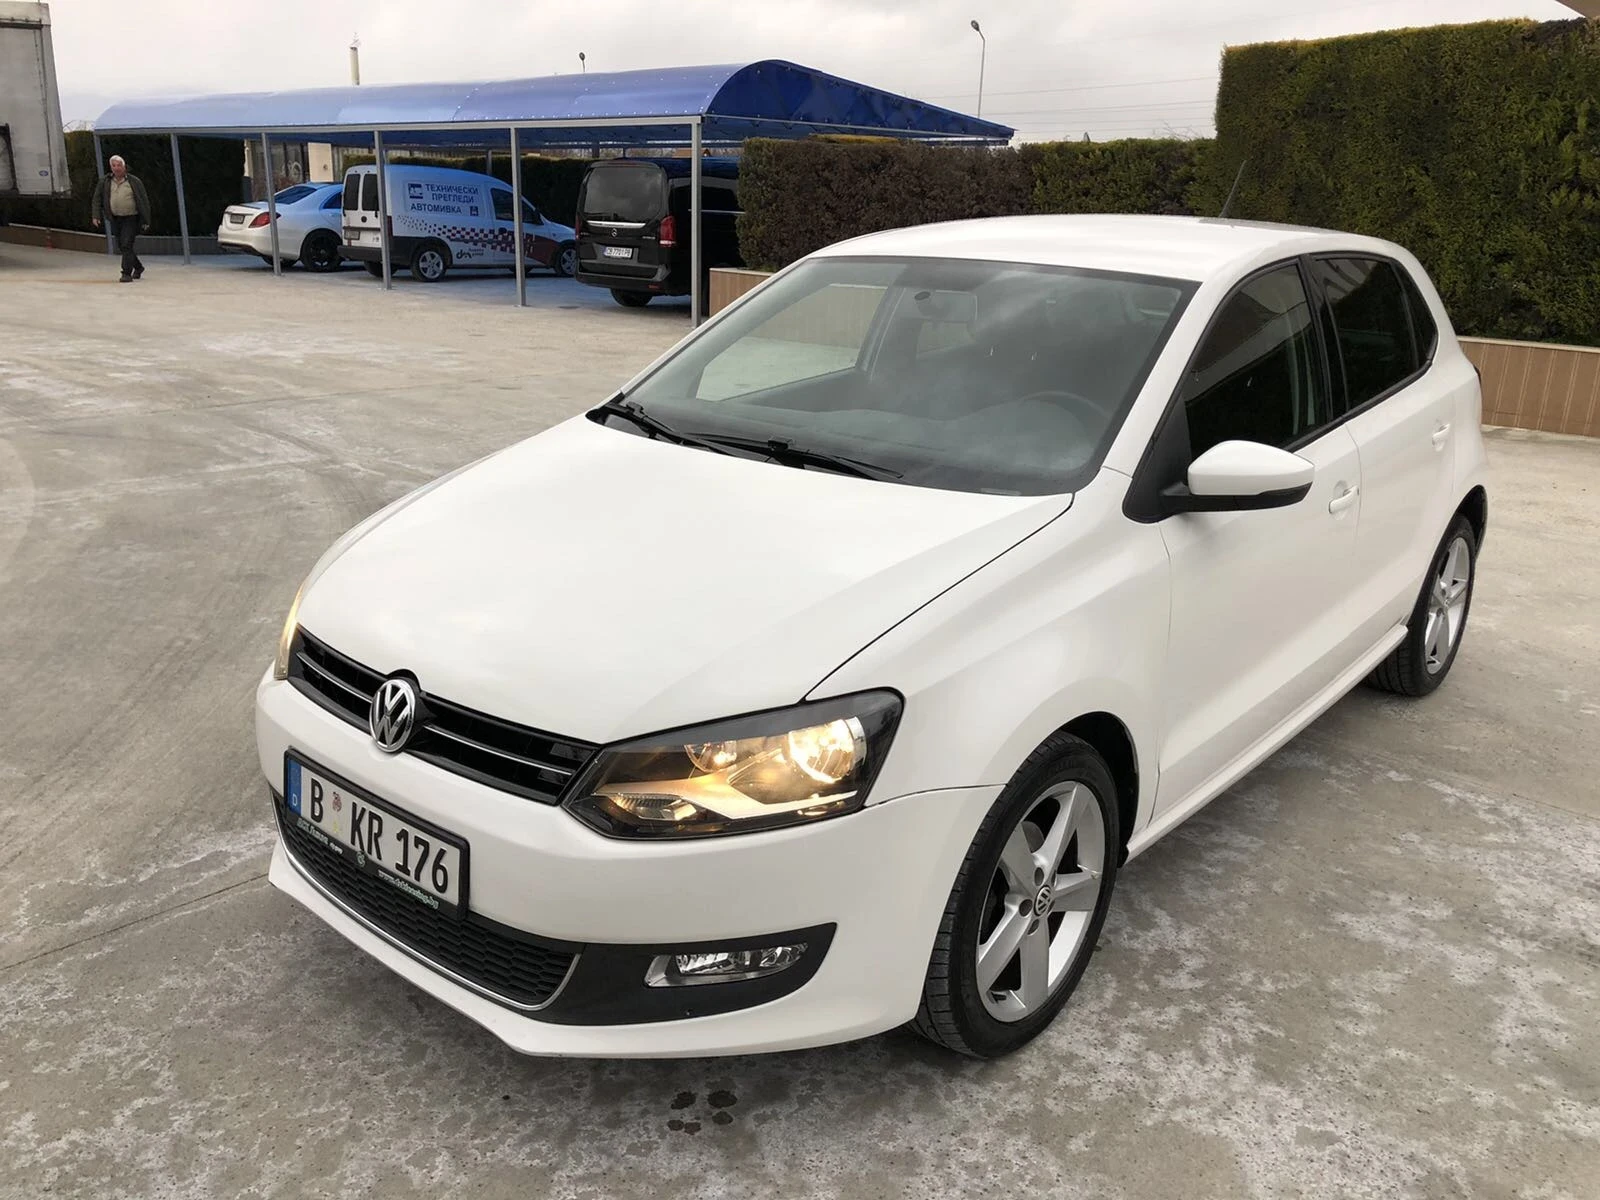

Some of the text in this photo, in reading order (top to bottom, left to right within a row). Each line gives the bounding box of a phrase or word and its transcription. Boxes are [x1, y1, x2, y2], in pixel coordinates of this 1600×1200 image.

[425, 184, 479, 195] ТЕХНИЧЕСКИ
[431, 193, 475, 204] ПРЕГЛЕДИ
[410, 202, 463, 214] АВТОМИВКА
[292, 793, 298, 806] D
[310, 778, 324, 824] B
[350, 801, 384, 861] KR
[395, 828, 448, 894] 176
